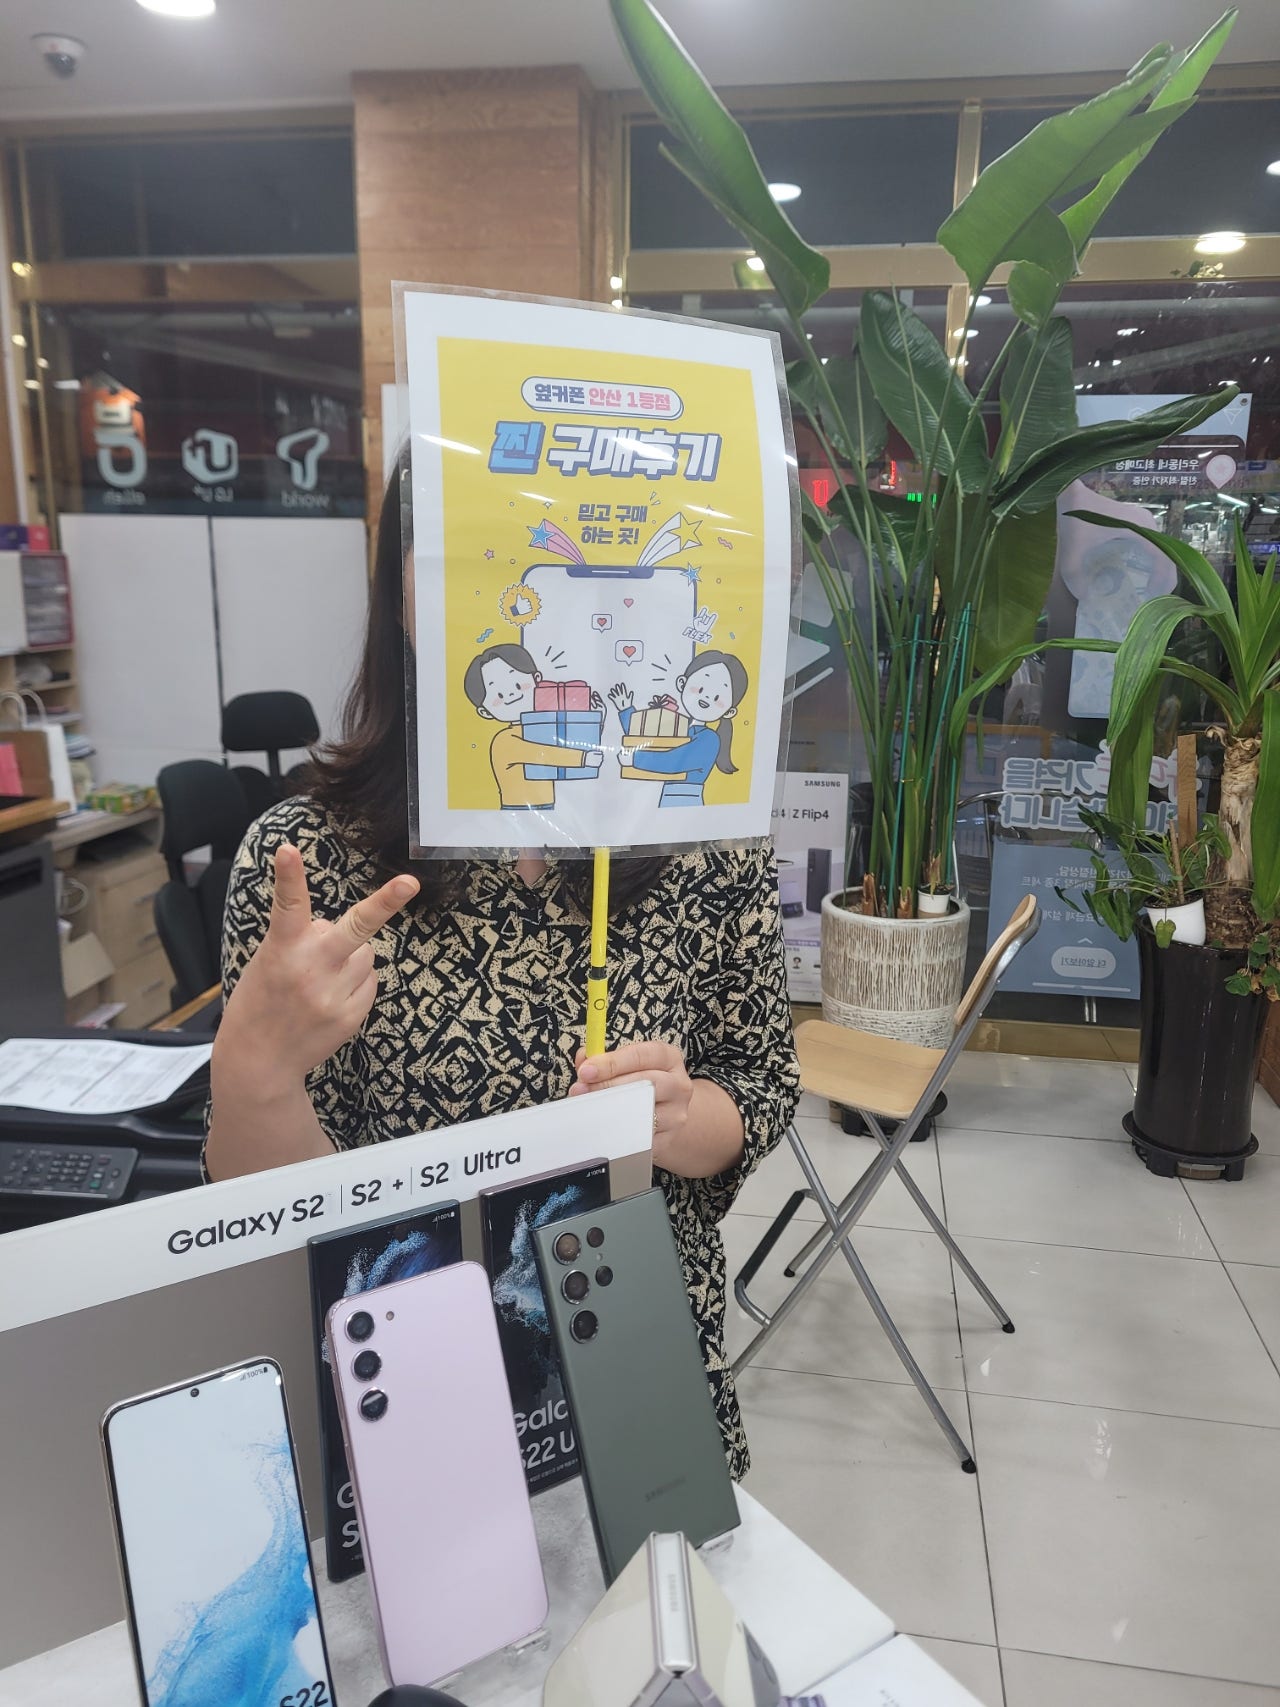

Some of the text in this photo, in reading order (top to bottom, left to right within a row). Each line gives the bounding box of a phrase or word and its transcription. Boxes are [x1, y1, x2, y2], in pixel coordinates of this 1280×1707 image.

[534, 383, 671, 411] 옆커폰 안산 1등점
[488, 420, 722, 481] 찐 구매후기
[577, 503, 648, 523] 믿고 구매
[580, 525, 640, 545] 하는 곳!
[682, 625, 712, 644] FLEX
[804, 780, 841, 788] SAMSUNG
[792, 808, 800, 819] Z
[802, 808, 829, 823] Flip4
[167, 1206, 286, 1255] Galaxy
[291, 1193, 325, 1223] S2
[420, 1162, 449, 1188] S2
[463, 1144, 522, 1176] Ultra
[247, 1368, 264, 1378] 100%
